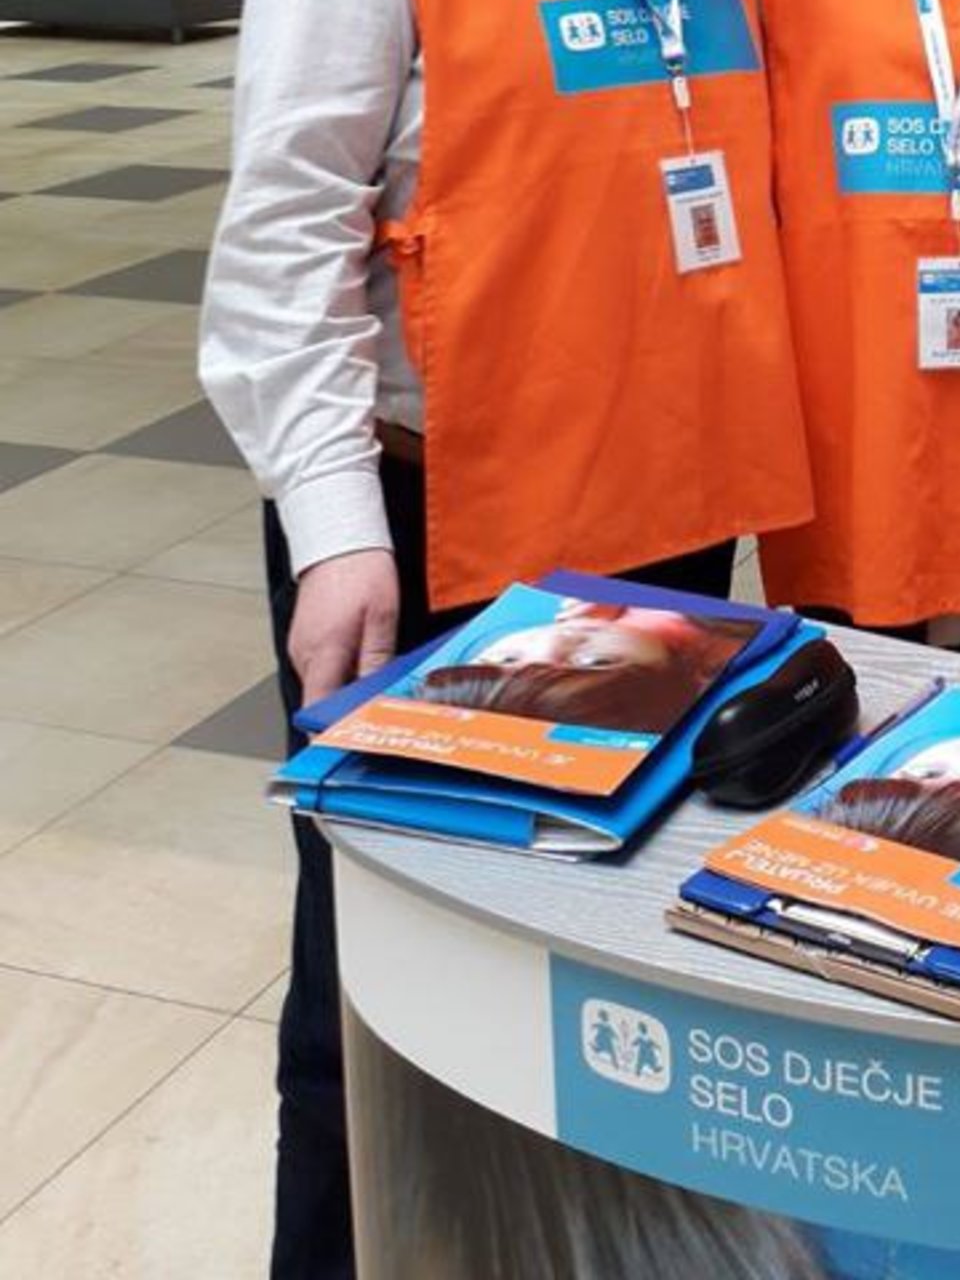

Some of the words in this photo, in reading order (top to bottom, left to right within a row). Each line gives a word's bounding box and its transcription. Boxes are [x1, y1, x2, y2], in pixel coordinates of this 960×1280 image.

[886, 137, 936, 156] SELO
[887, 118, 926, 135] SOS
[688, 1028, 771, 1078] SOS
[783, 1050, 944, 1111] DJEČJE
[690, 1075, 794, 1128] SELO
[691, 1123, 909, 1202] HRVATSKA
